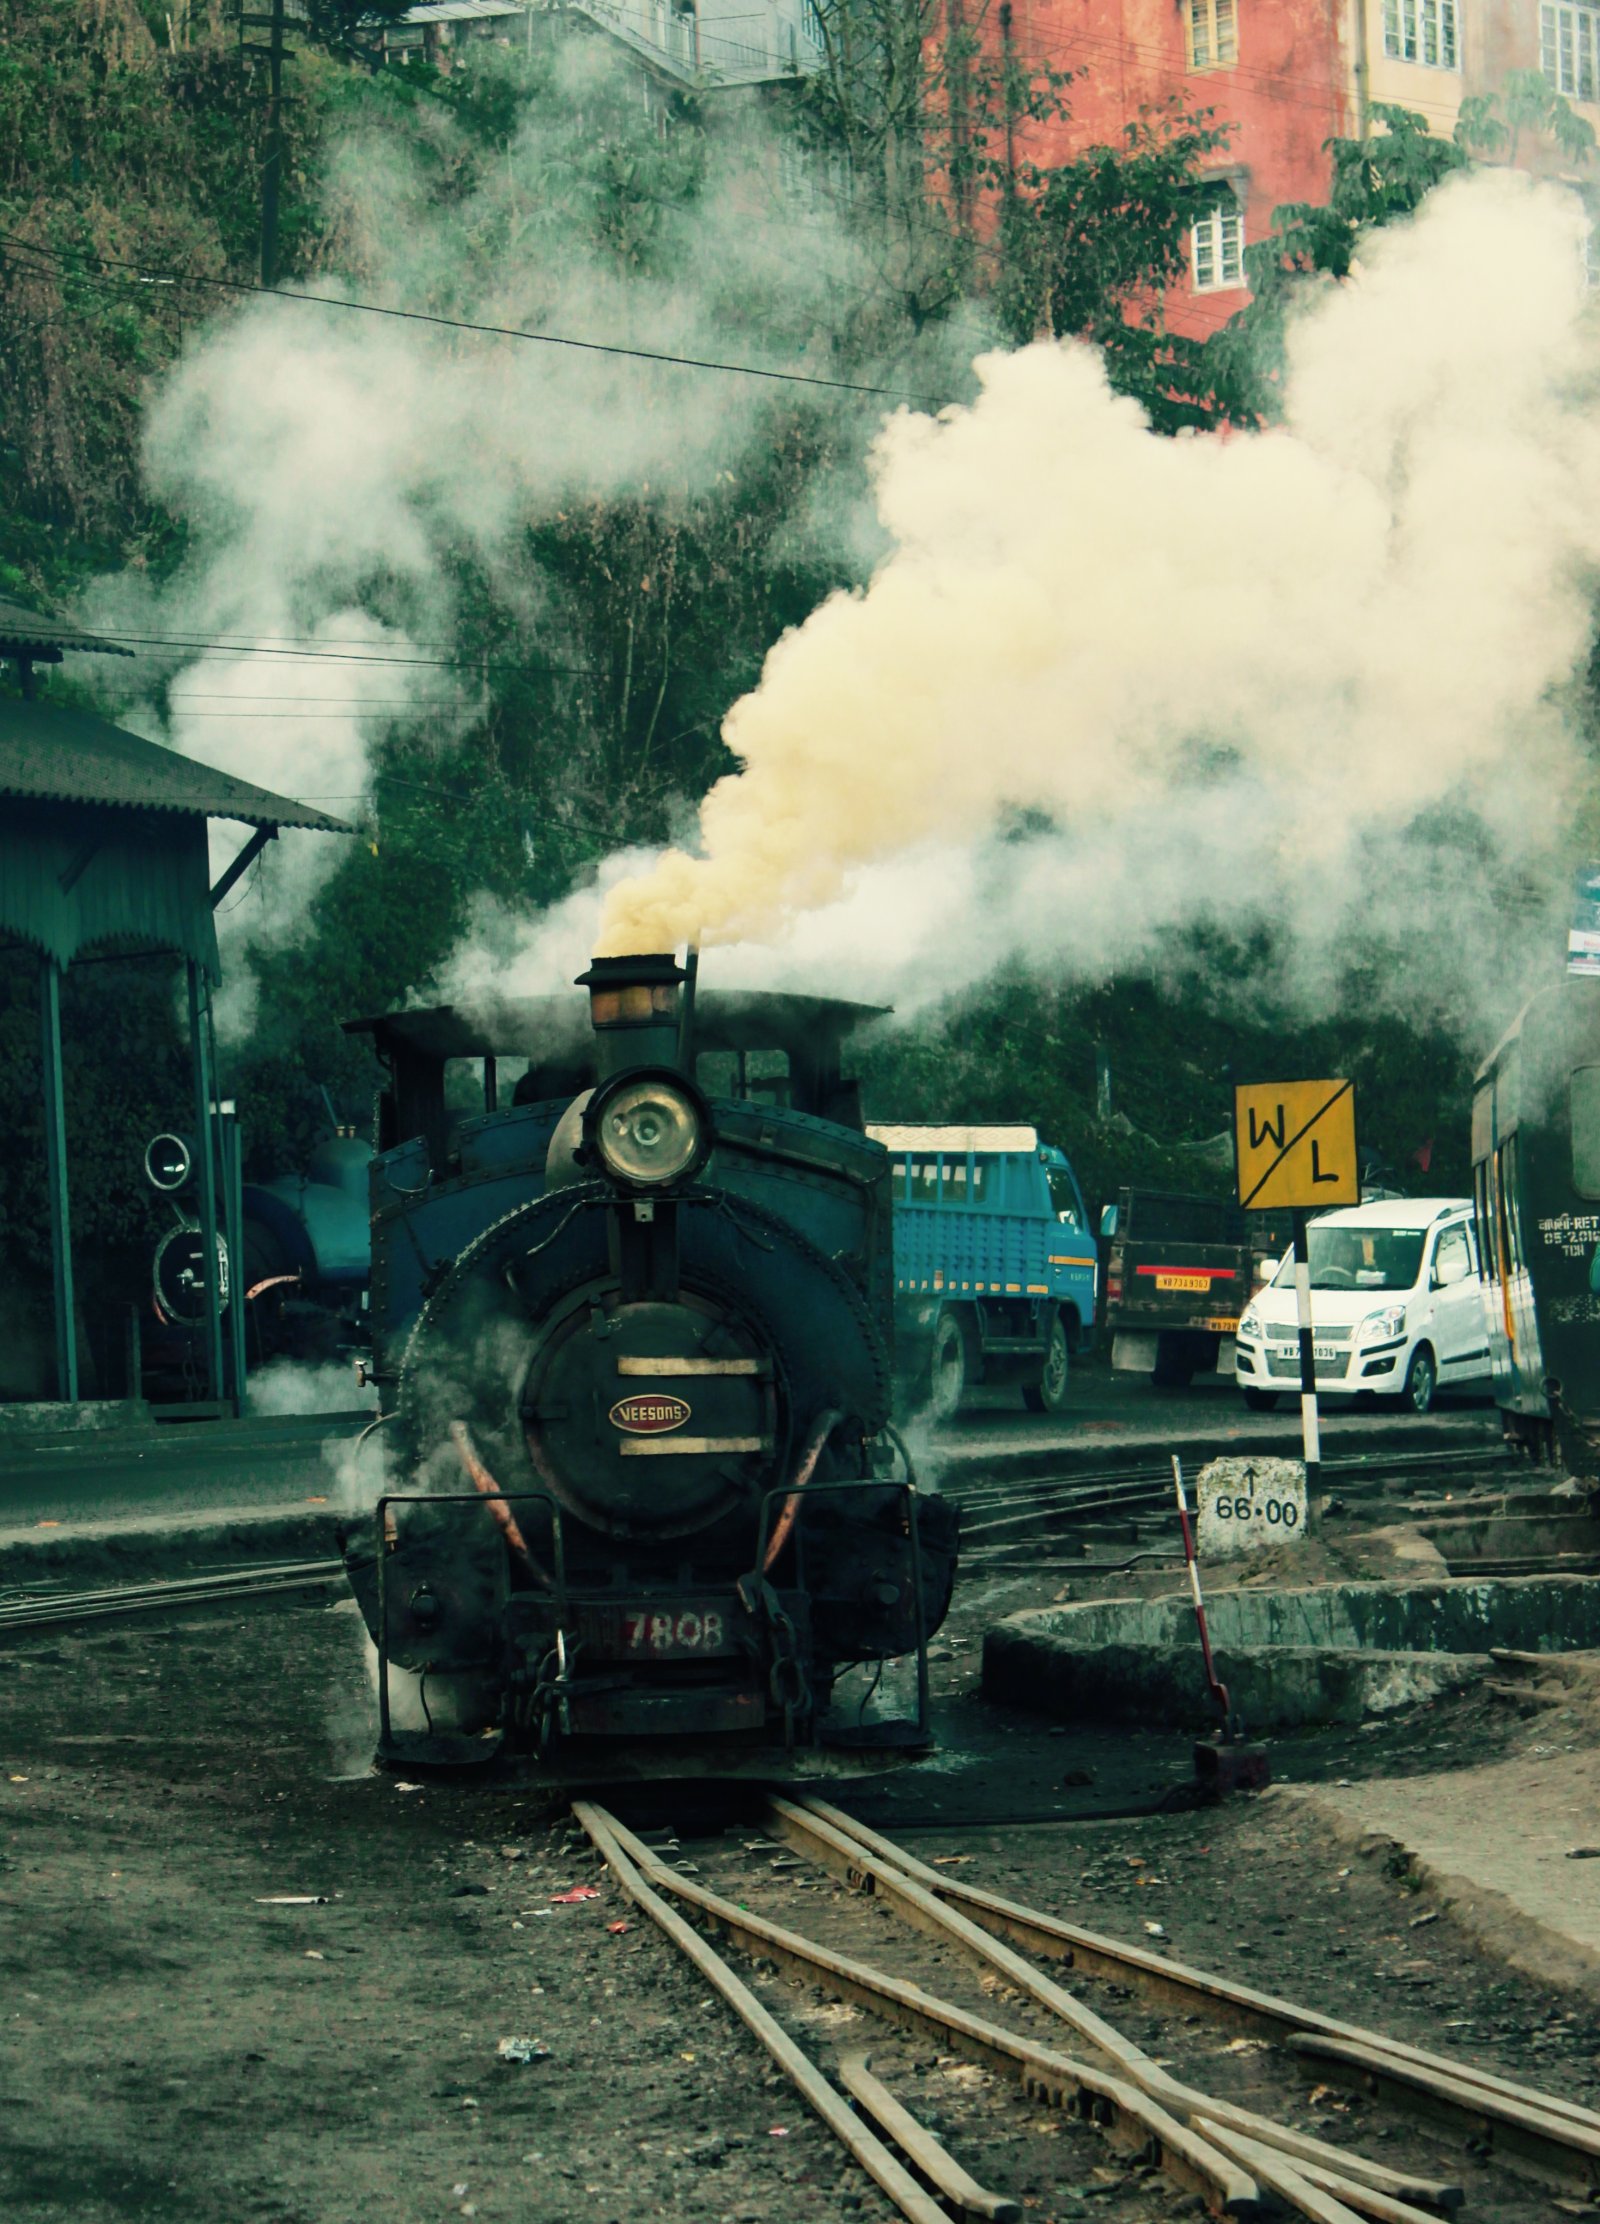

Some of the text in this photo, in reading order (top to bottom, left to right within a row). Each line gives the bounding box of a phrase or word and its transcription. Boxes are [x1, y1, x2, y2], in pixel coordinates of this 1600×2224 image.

[1248, 1103, 1285, 1150] W
[1311, 1139, 1339, 1184] L
[619, 1405, 682, 1421] VEESONS
